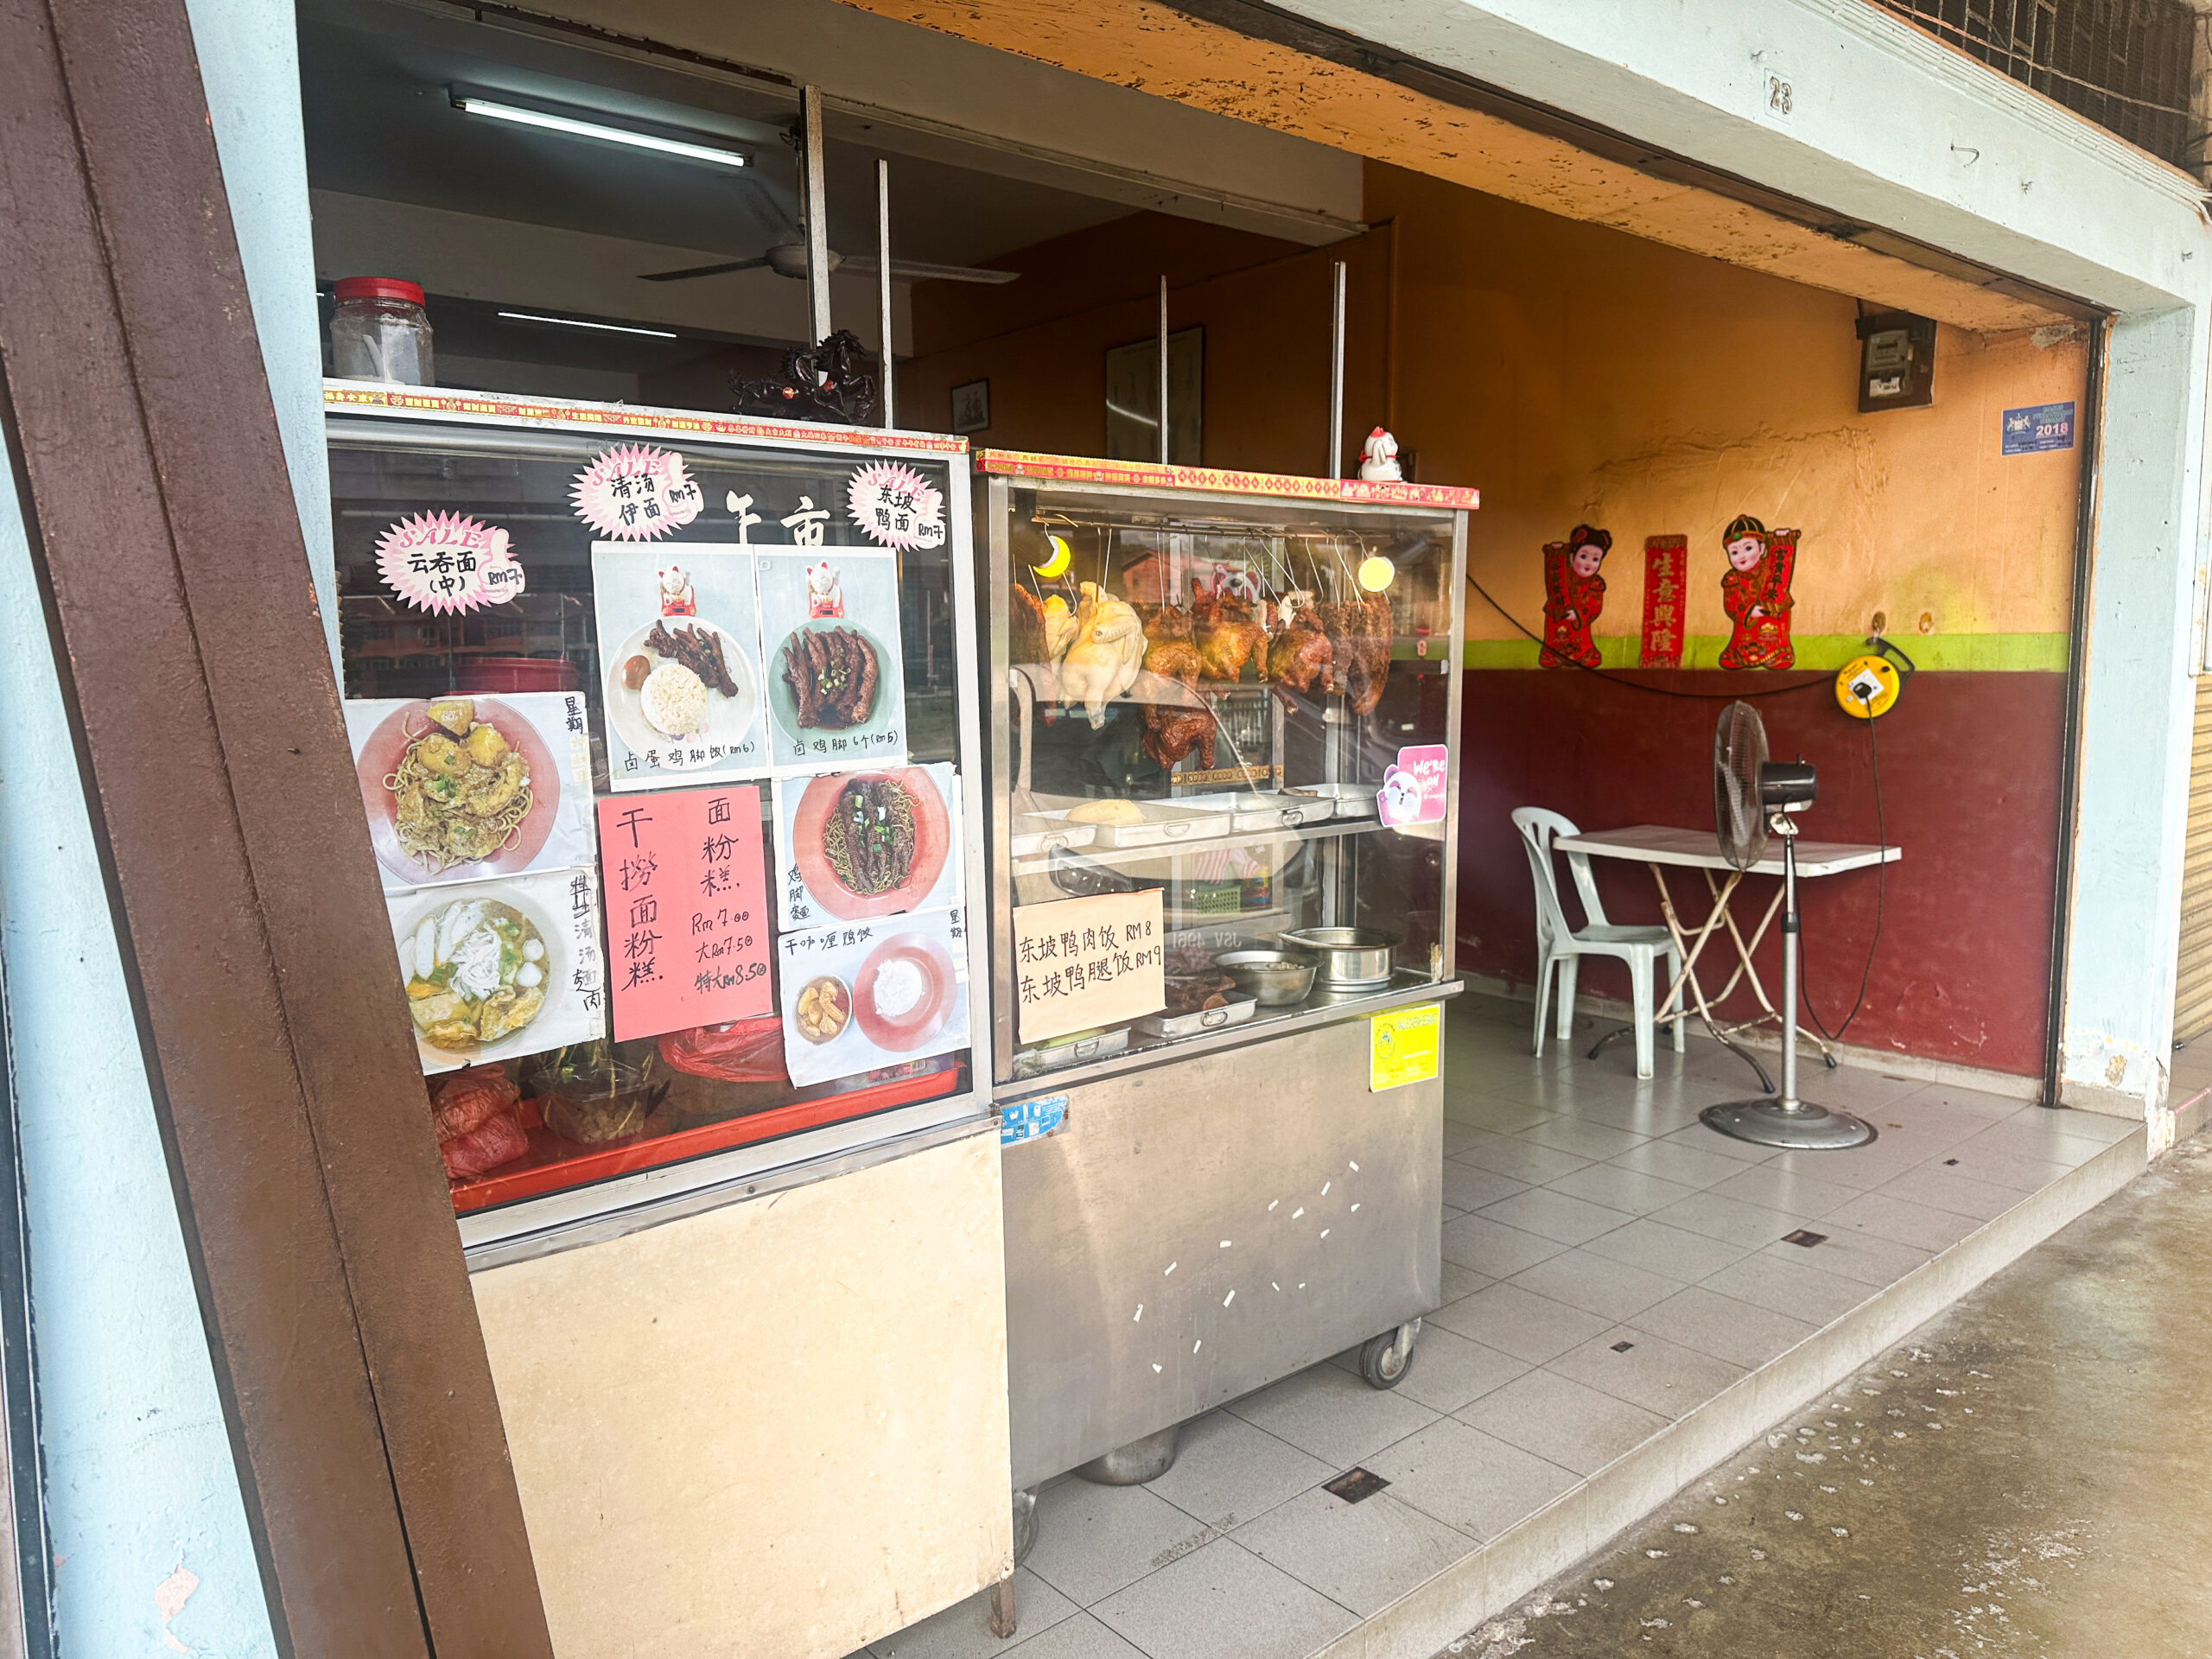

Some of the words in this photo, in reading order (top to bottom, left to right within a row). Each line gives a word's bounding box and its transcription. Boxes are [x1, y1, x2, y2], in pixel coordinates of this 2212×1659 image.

[1770, 76, 1792, 114] 23
[2036, 422, 2069, 437] 2018
[592, 460, 660, 486] SALE
[868, 473, 925, 501] SALE
[400, 527, 482, 549] SALE
